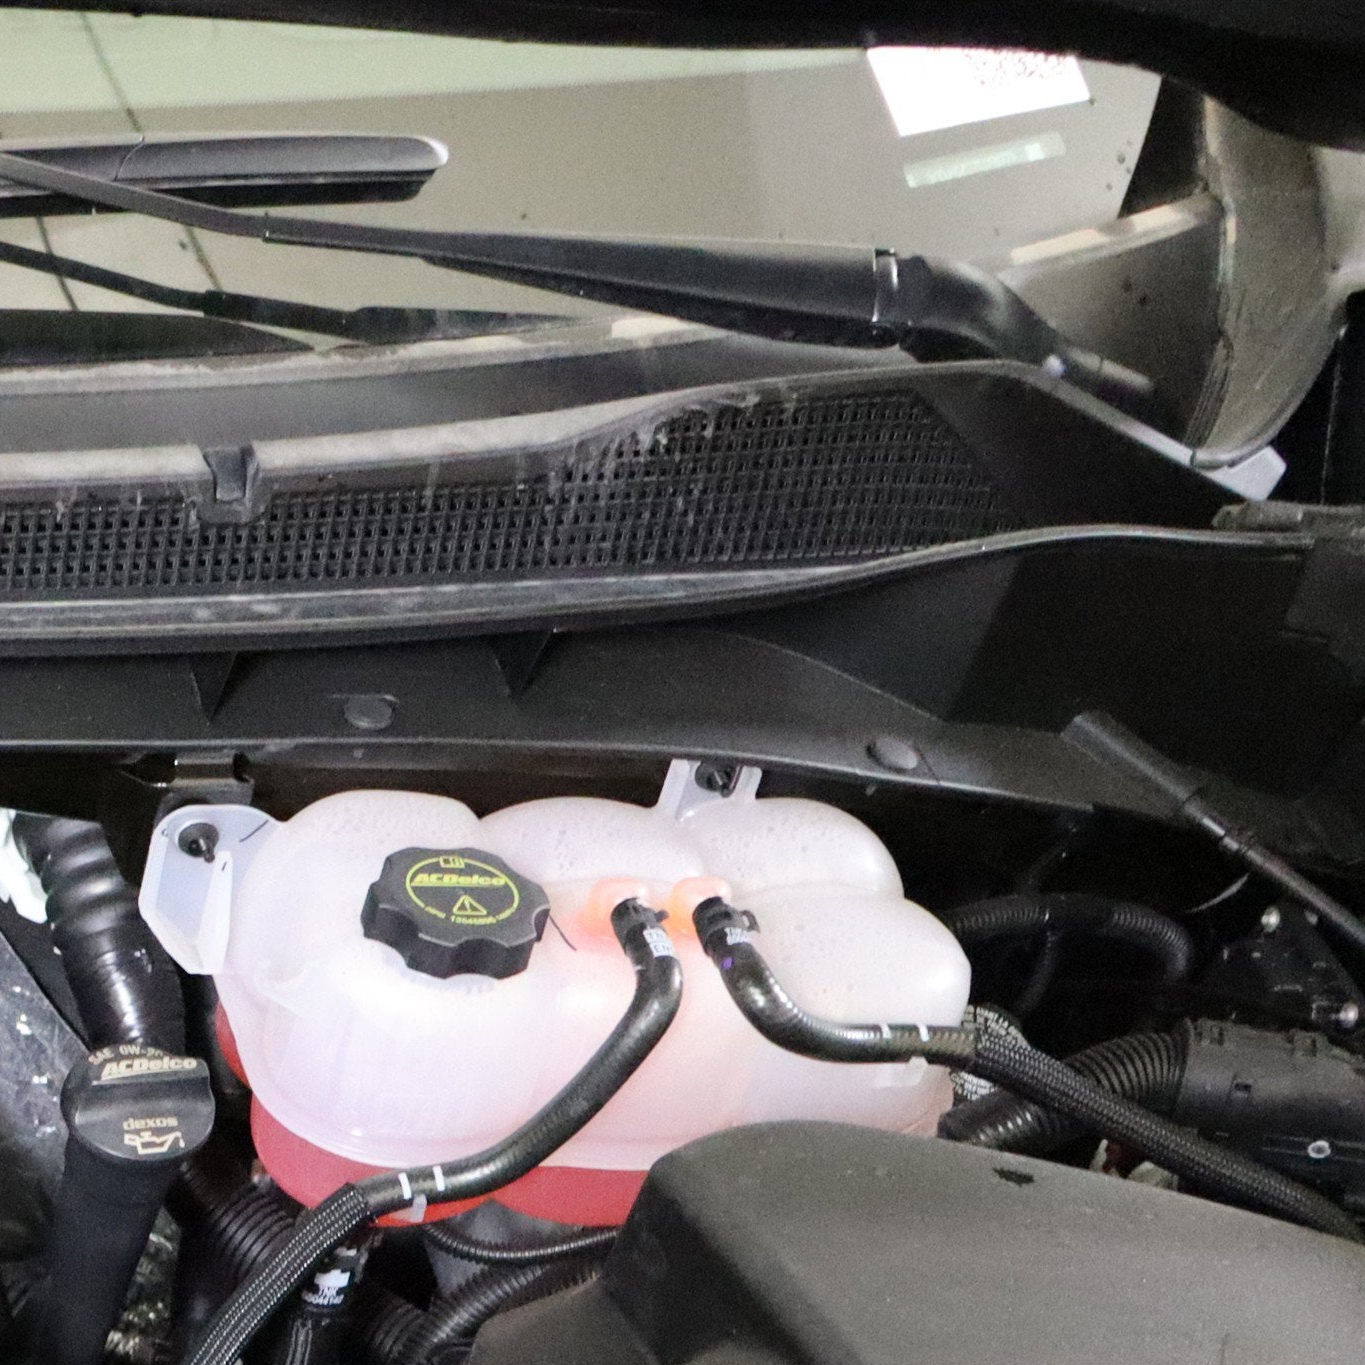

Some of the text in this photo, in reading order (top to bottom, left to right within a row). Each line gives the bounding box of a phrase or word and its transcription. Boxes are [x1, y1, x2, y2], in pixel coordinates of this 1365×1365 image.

[411, 873, 508, 887] ACDelco
[88, 1048, 115, 1065] SAE
[101, 1057, 198, 1080] ACDelco
[123, 1116, 178, 1130] dexos
